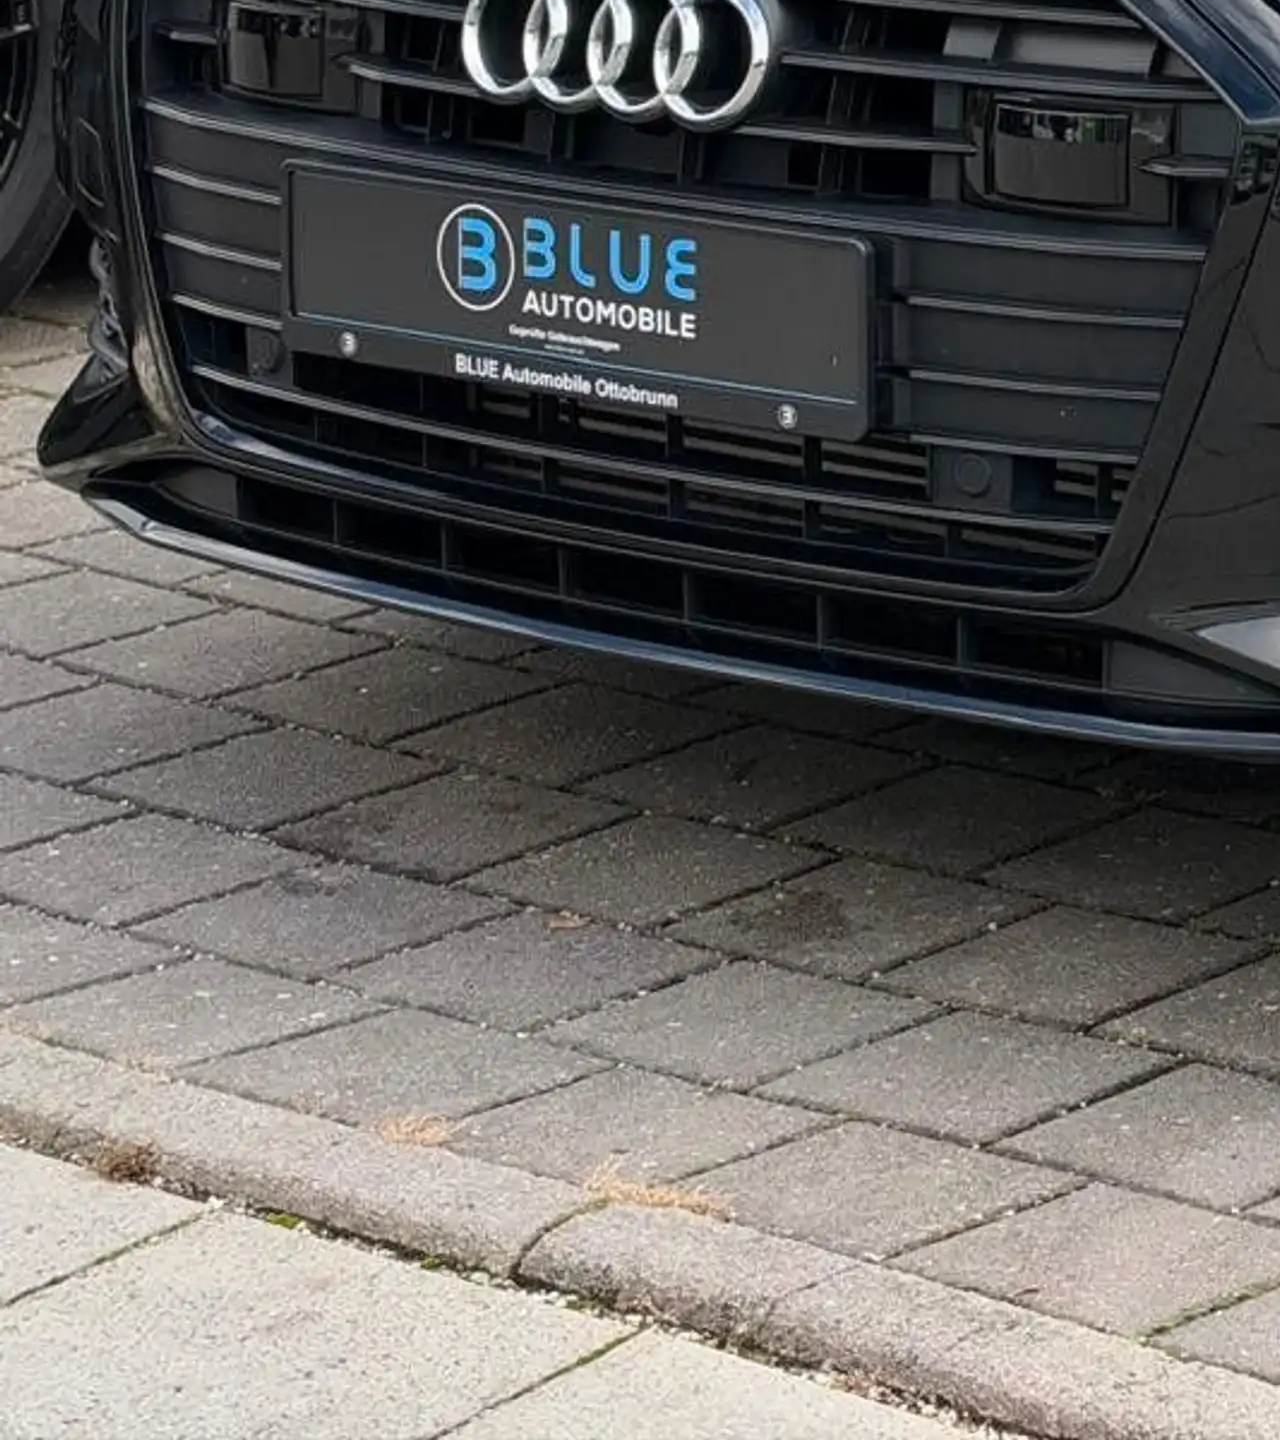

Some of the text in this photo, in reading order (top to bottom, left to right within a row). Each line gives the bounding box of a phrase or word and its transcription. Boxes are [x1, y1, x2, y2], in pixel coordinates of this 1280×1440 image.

[523, 216, 697, 302] BLUE
[522, 289, 697, 339] AUTOMOBILE
[455, 352, 679, 409] BLUE Automobile Ottobrunn
